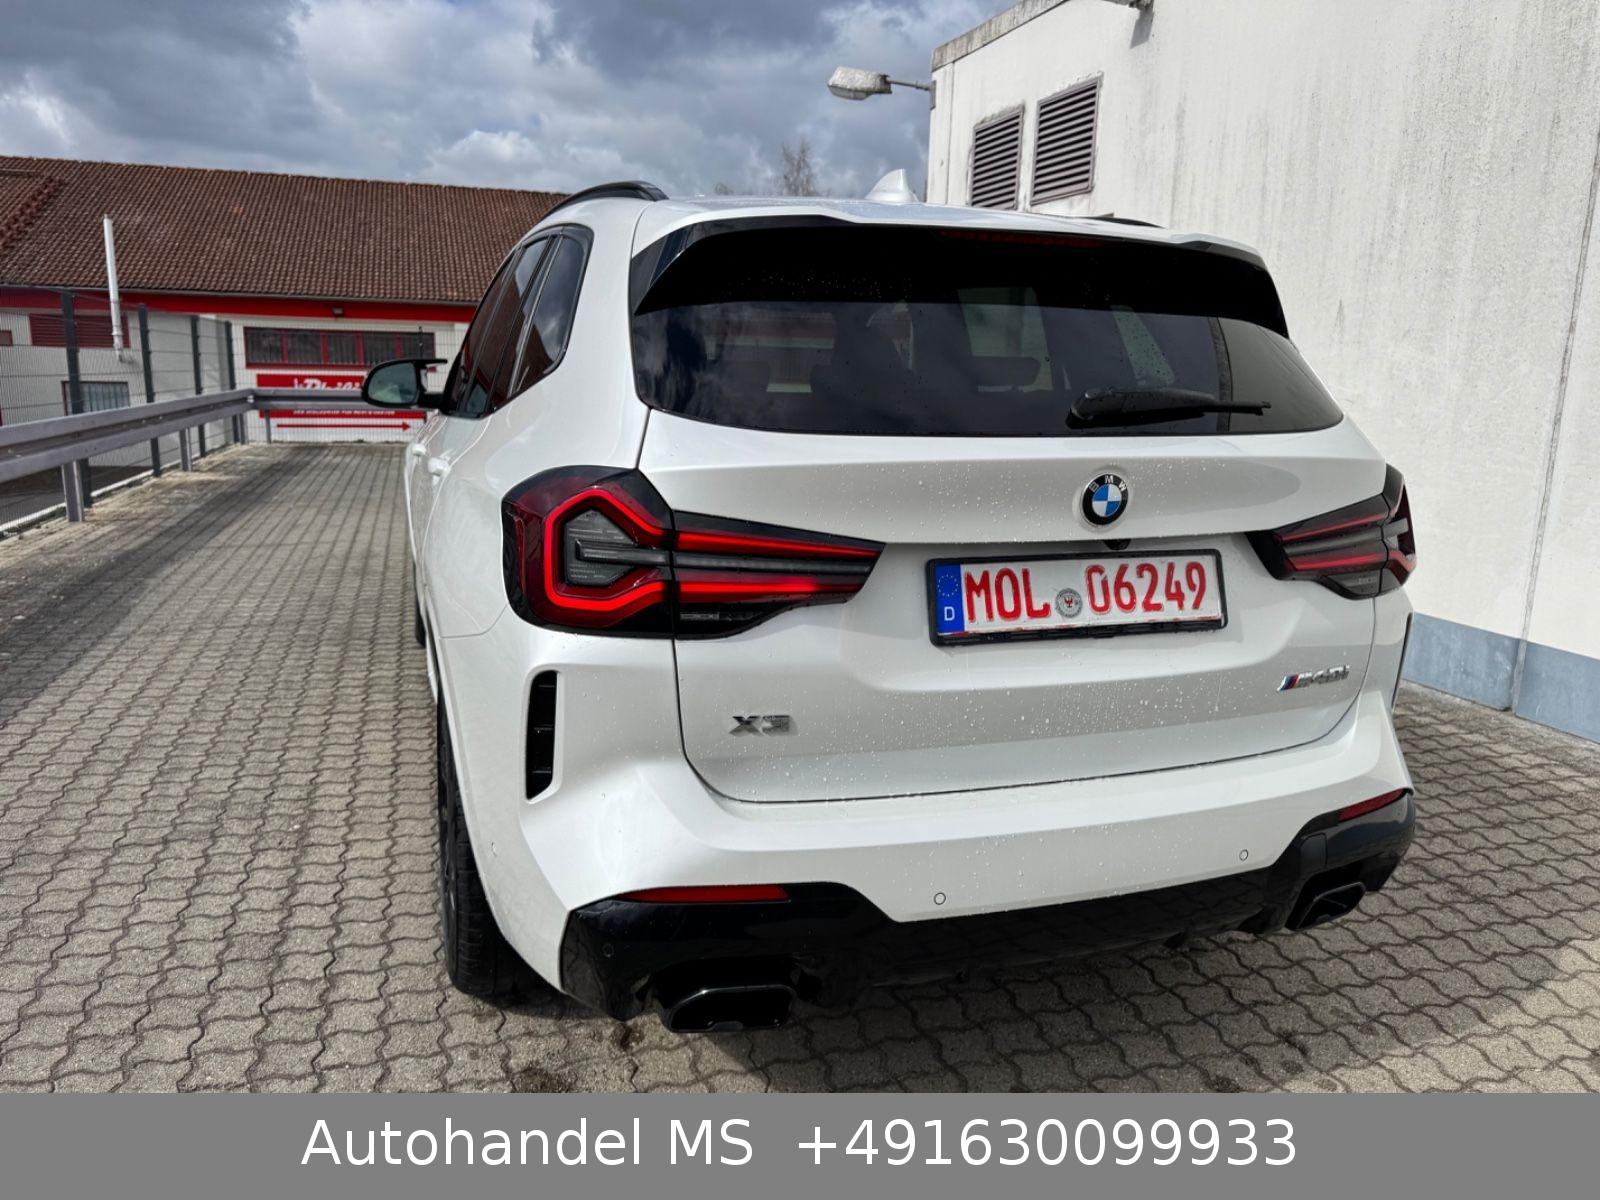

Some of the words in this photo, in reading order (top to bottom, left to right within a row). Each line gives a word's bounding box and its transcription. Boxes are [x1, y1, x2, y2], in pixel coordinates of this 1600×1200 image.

[1089, 475, 1127, 493] BMW
[964, 568, 1051, 623] MOL
[1085, 561, 1206, 615] 06249
[943, 606, 954, 621] D
[730, 714, 790, 736] X3
